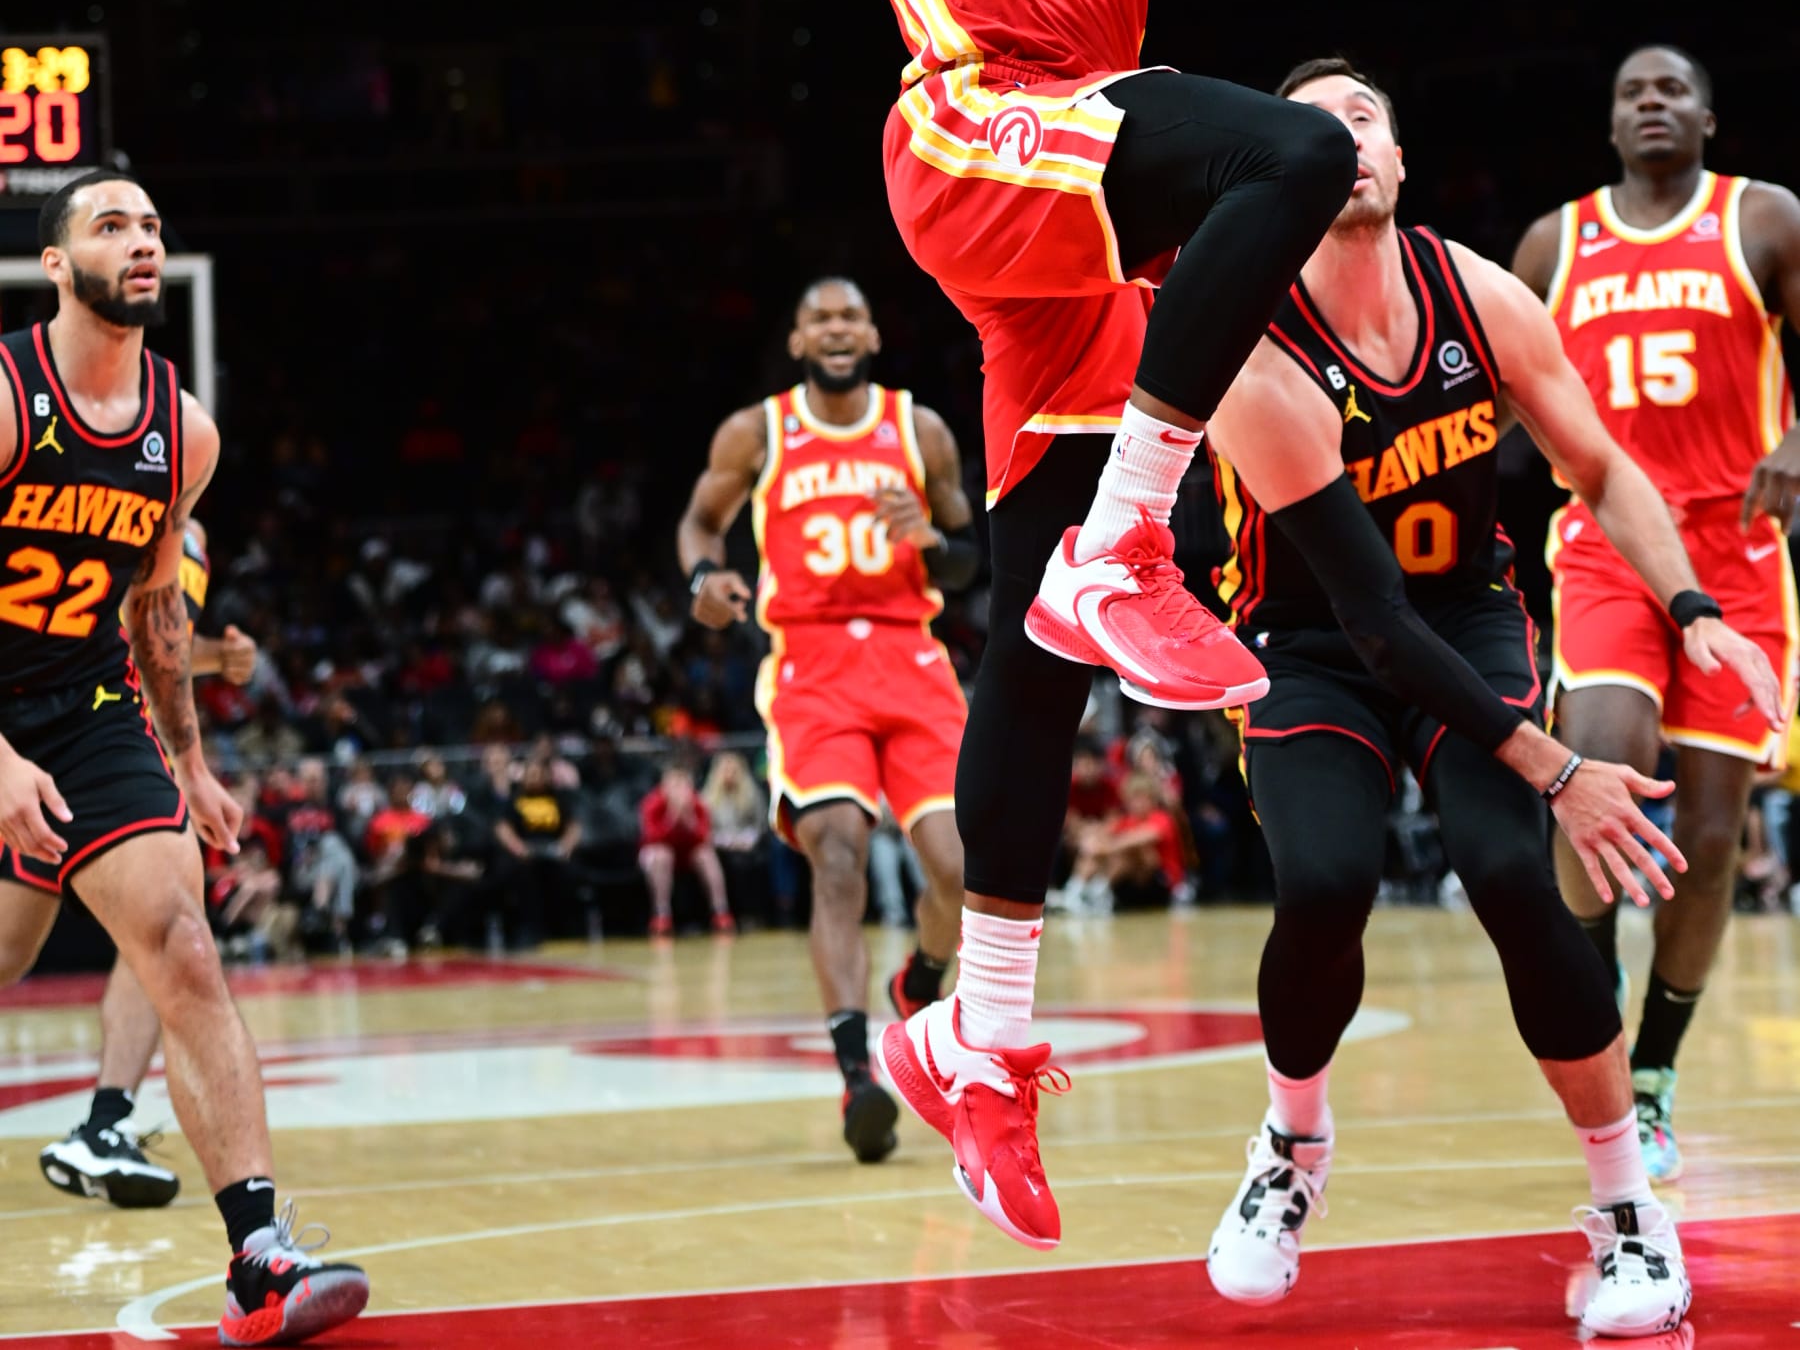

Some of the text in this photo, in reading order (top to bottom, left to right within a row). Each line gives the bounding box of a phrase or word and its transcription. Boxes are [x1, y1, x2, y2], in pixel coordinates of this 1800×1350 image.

[1570, 268, 1733, 331] ATLANTA
[1324, 364, 1346, 390] 6
[1604, 329, 1699, 410] 15
[34, 393, 51, 417] 6
[1, 484, 166, 547] HAWKS
[803, 513, 895, 576] 30
[1394, 501, 1459, 576] 0
[0, 546, 113, 638] 22
